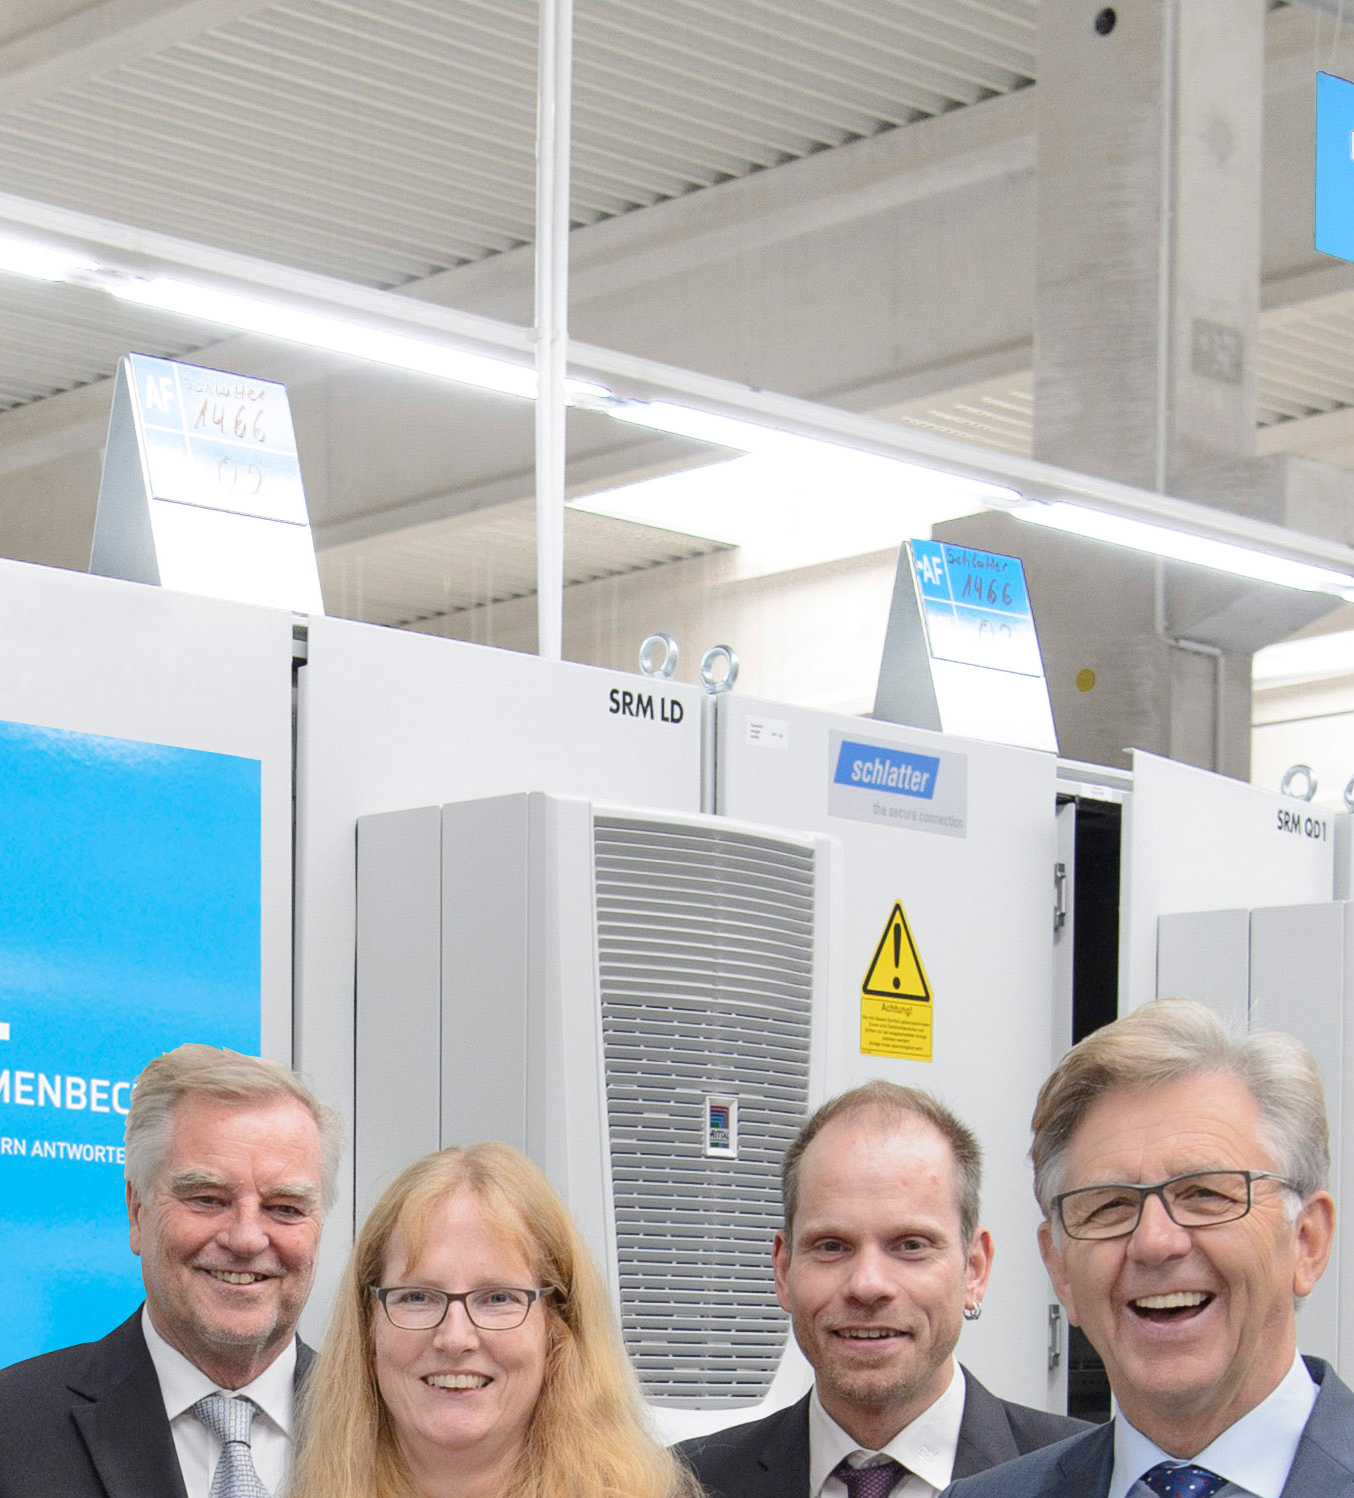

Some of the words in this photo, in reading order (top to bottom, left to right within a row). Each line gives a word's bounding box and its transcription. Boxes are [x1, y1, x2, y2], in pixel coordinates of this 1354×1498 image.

[146, 375, 174, 412] AF
[195, 398, 267, 443] 1466
[962, 572, 1013, 606] 1466
[609, 688, 655, 721] SRM
[660, 697, 685, 724] LD
[851, 757, 931, 793] schlatter
[1276, 809, 1302, 835] SRM
